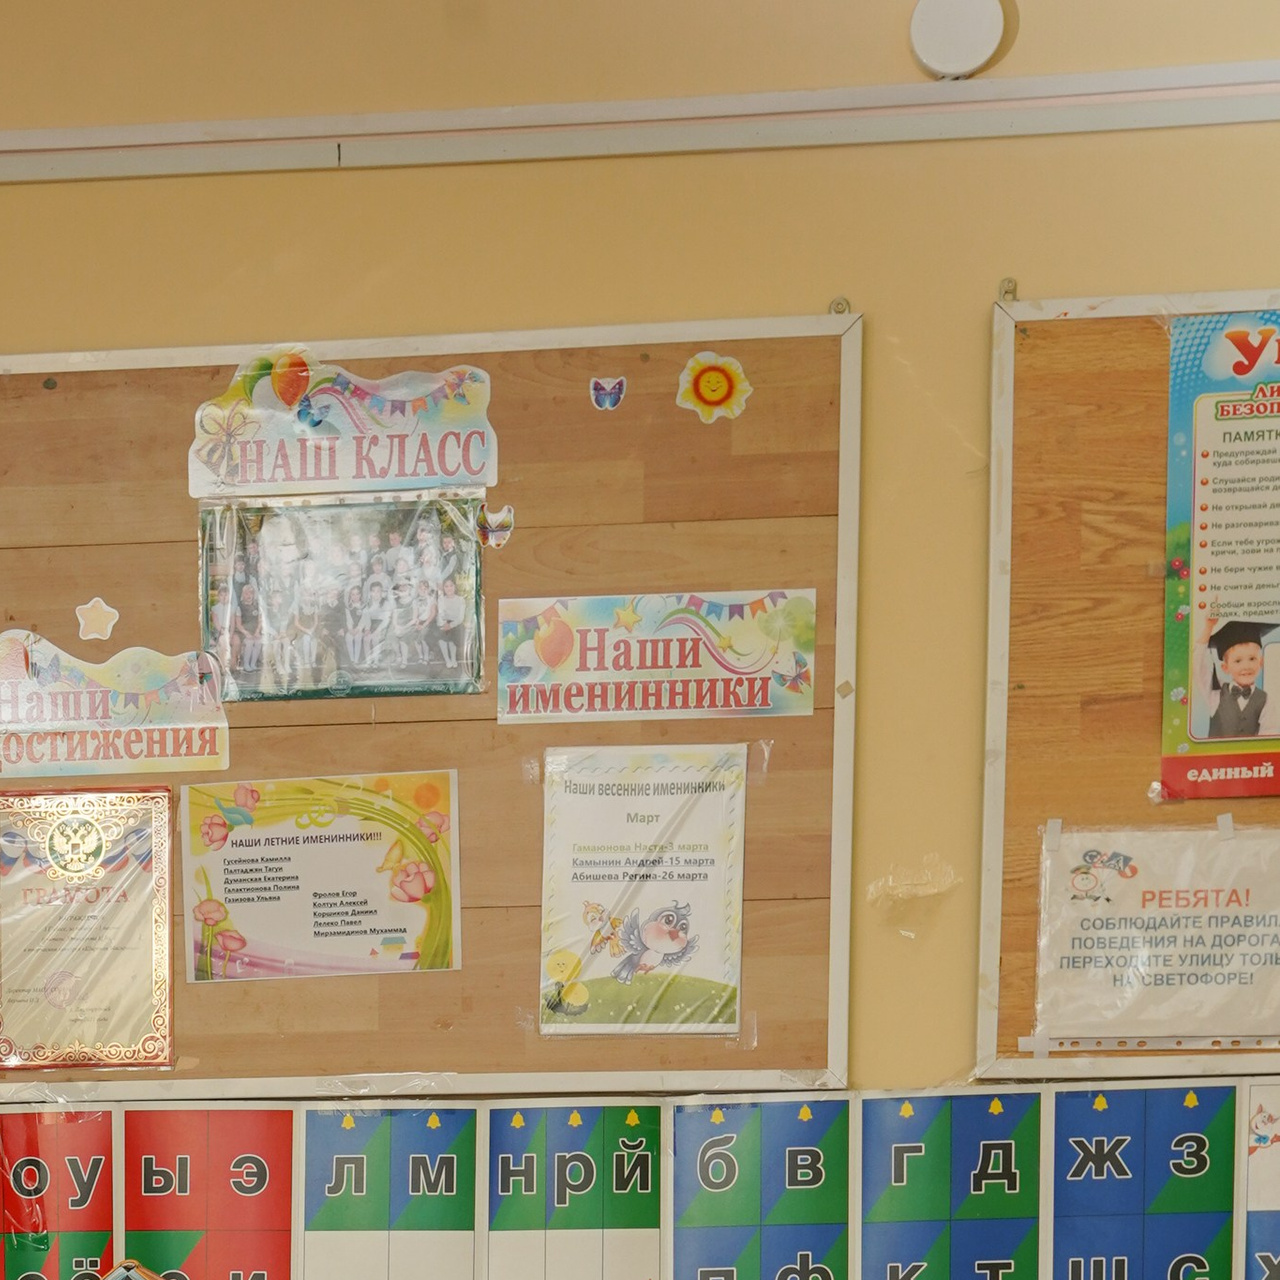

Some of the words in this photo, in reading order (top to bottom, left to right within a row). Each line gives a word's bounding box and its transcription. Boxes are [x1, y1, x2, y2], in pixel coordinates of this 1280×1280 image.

[237, 436, 340, 483] НАШ
[352, 430, 486, 479] КЛАСС
[1213, 448, 1277, 459] Предупреждай
[1212, 459, 1232, 467] куда
[1212, 476, 1256, 485] Слушайся
[1212, 484, 1270, 494] возвращайся
[1225, 501, 1267, 511] открывай
[1211, 540, 1232, 548] Если
[1235, 538, 1254, 546] тебе
[1224, 566, 1244, 574] бери
[1247, 565, 1273, 573] чужие
[1224, 583, 1253, 591] считай
[1210, 601, 1244, 609] Сообщи
[1210, 610, 1240, 618] людях,
[575, 628, 704, 672] Наши
[506, 676, 771, 715] именинники
[1187, 762, 1275, 783] единый
[565, 780, 595, 794] Наши
[598, 782, 650, 796] весенние
[653, 780, 725, 796] именинники
[626, 813, 660, 824] Март
[231, 839, 261, 847] НАШИ
[264, 837, 299, 847] ЛЕТНИЕ
[303, 832, 382, 844] ИМЕНИННИКИ!!!
[573, 843, 631, 853] Гамаюнова
[678, 843, 708, 852] марта
[223, 857, 258, 865] Гусейнова
[572, 858, 620, 867] Камынин
[624, 857, 680, 867] Андрей-15
[684, 858, 715, 867] марта
[224, 876, 262, 884] Думанская
[264, 874, 299, 883] Екатерина
[572, 872, 619, 881] Абишева
[623, 872, 674, 881] Регина-26
[677, 872, 708, 881] марта
[224, 886, 271, 894] Галактионова
[342, 890, 357, 898] Егор
[22, 886, 130, 906] ГРАМОТА
[225, 896, 255, 904] Газизова
[1141, 889, 1250, 909] РЕБЯТА!
[313, 901, 338, 909] Колтун
[340, 899, 368, 907] Алексей
[313, 910, 349, 918] Коршиков
[313, 920, 339, 928] Лелеко
[1080, 914, 1202, 932] СОБЛЮДАЙТЕ
[1208, 914, 1280, 929] ПРАВИЛ
[370, 927, 407, 935] Мухаммад
[1071, 935, 1177, 952] ПОВЕДЕНИЯ
[1183, 935, 1206, 948] НА
[1211, 933, 1280, 950] ДОРОГА
[1060, 953, 1173, 970] ПЕРЕХОДИТЕ
[1178, 953, 1234, 969] УЛИЦУ
[1142, 972, 1254, 988] СВЕТОФОРЕ!
[1067, 1136, 1132, 1181] ж
[1169, 1133, 1210, 1178] з
[696, 1134, 738, 1192] б
[785, 1147, 826, 1189] в
[891, 1143, 925, 1186] г
[970, 1140, 1020, 1193] д
[142, 1155, 189, 1196] ы
[230, 1156, 269, 1196] э
[326, 1155, 367, 1196] л
[409, 1154, 456, 1195] м
[499, 1154, 537, 1195] н
[554, 1152, 596, 1206] р
[612, 1138, 652, 1193] й
[10, 1160, 50, 1197] о
[65, 1156, 105, 1207] у
